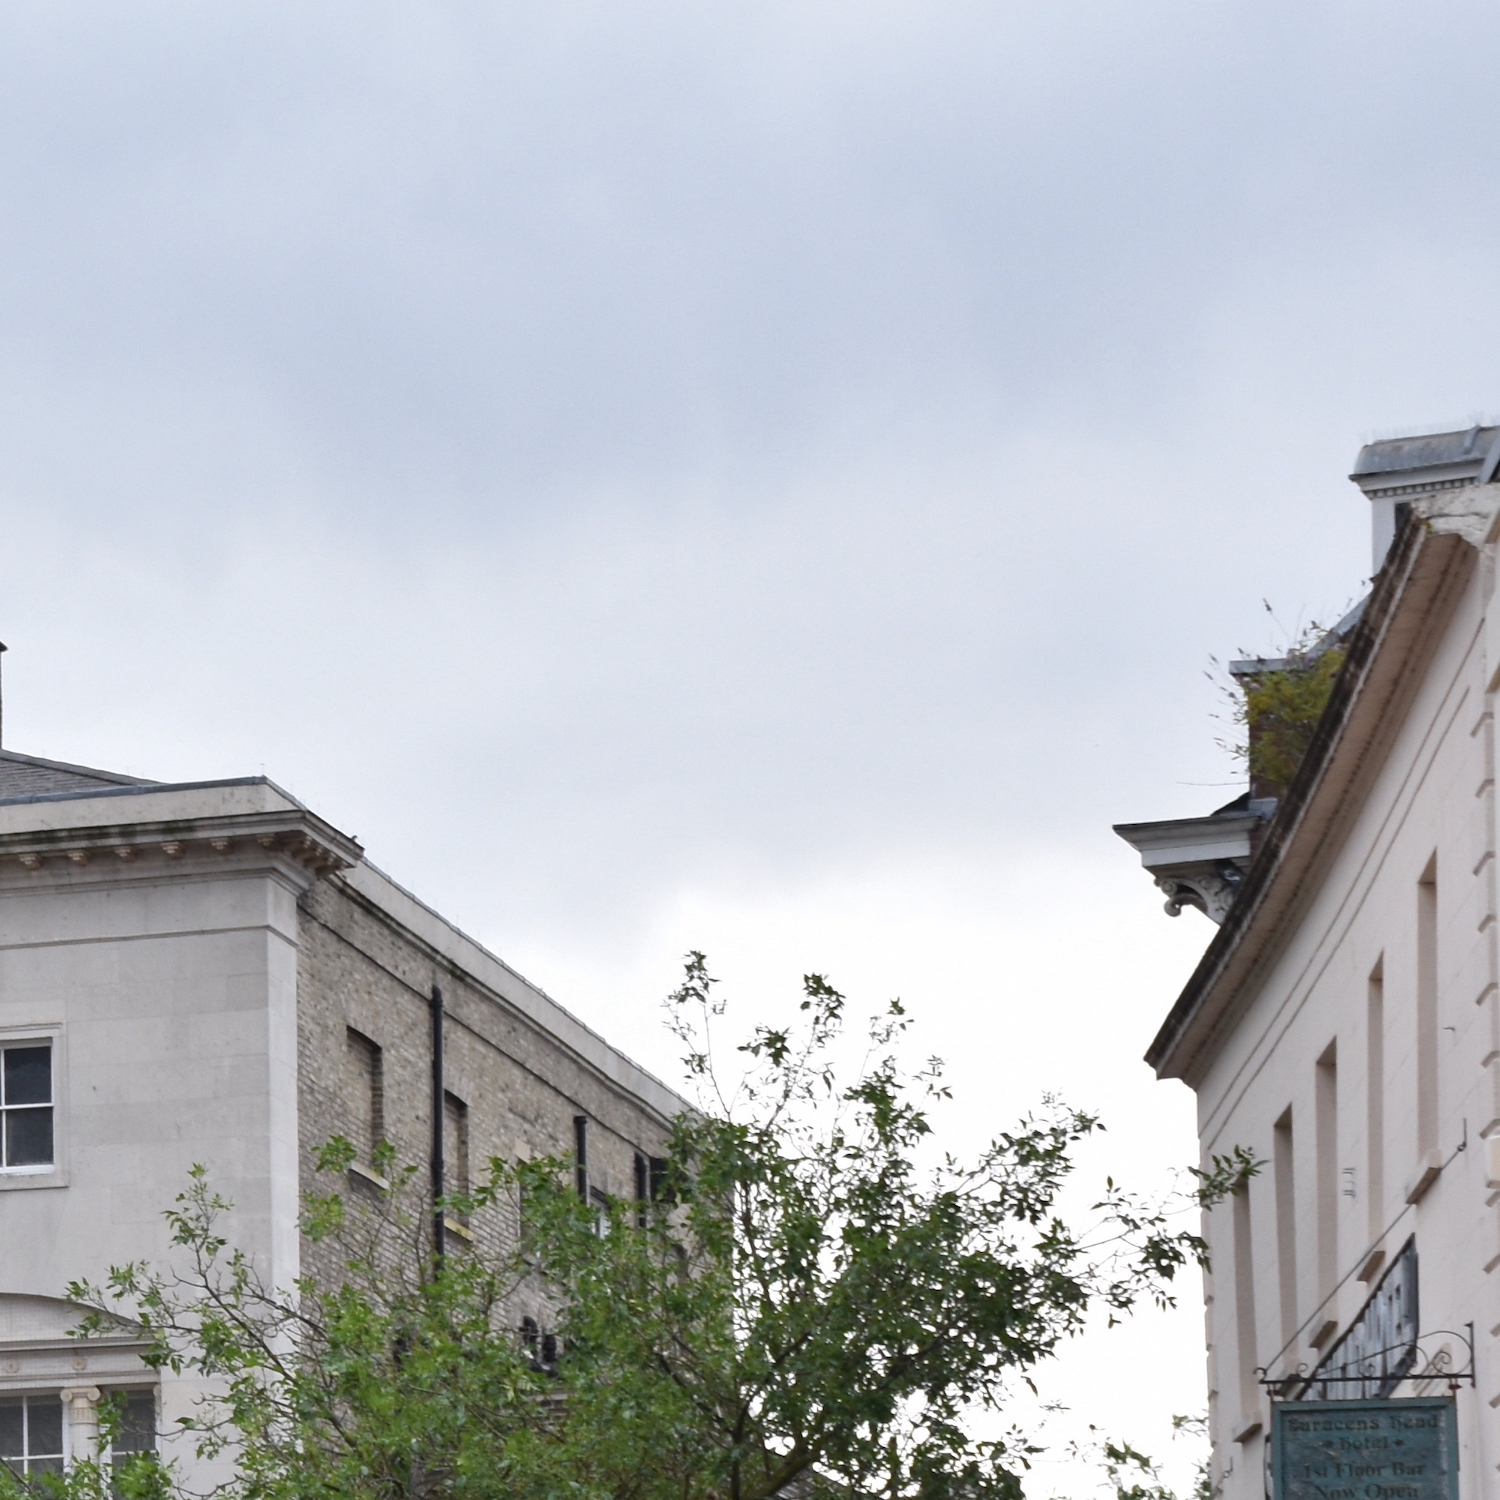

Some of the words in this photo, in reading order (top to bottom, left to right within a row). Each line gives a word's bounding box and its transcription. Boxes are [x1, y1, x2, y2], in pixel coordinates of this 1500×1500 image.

[1287, 1417, 1380, 1432] Saracens
[1335, 1462, 1385, 1478] Floor
[1392, 1461, 1425, 1476] Bar
[1312, 1483, 1356, 1500] Now
